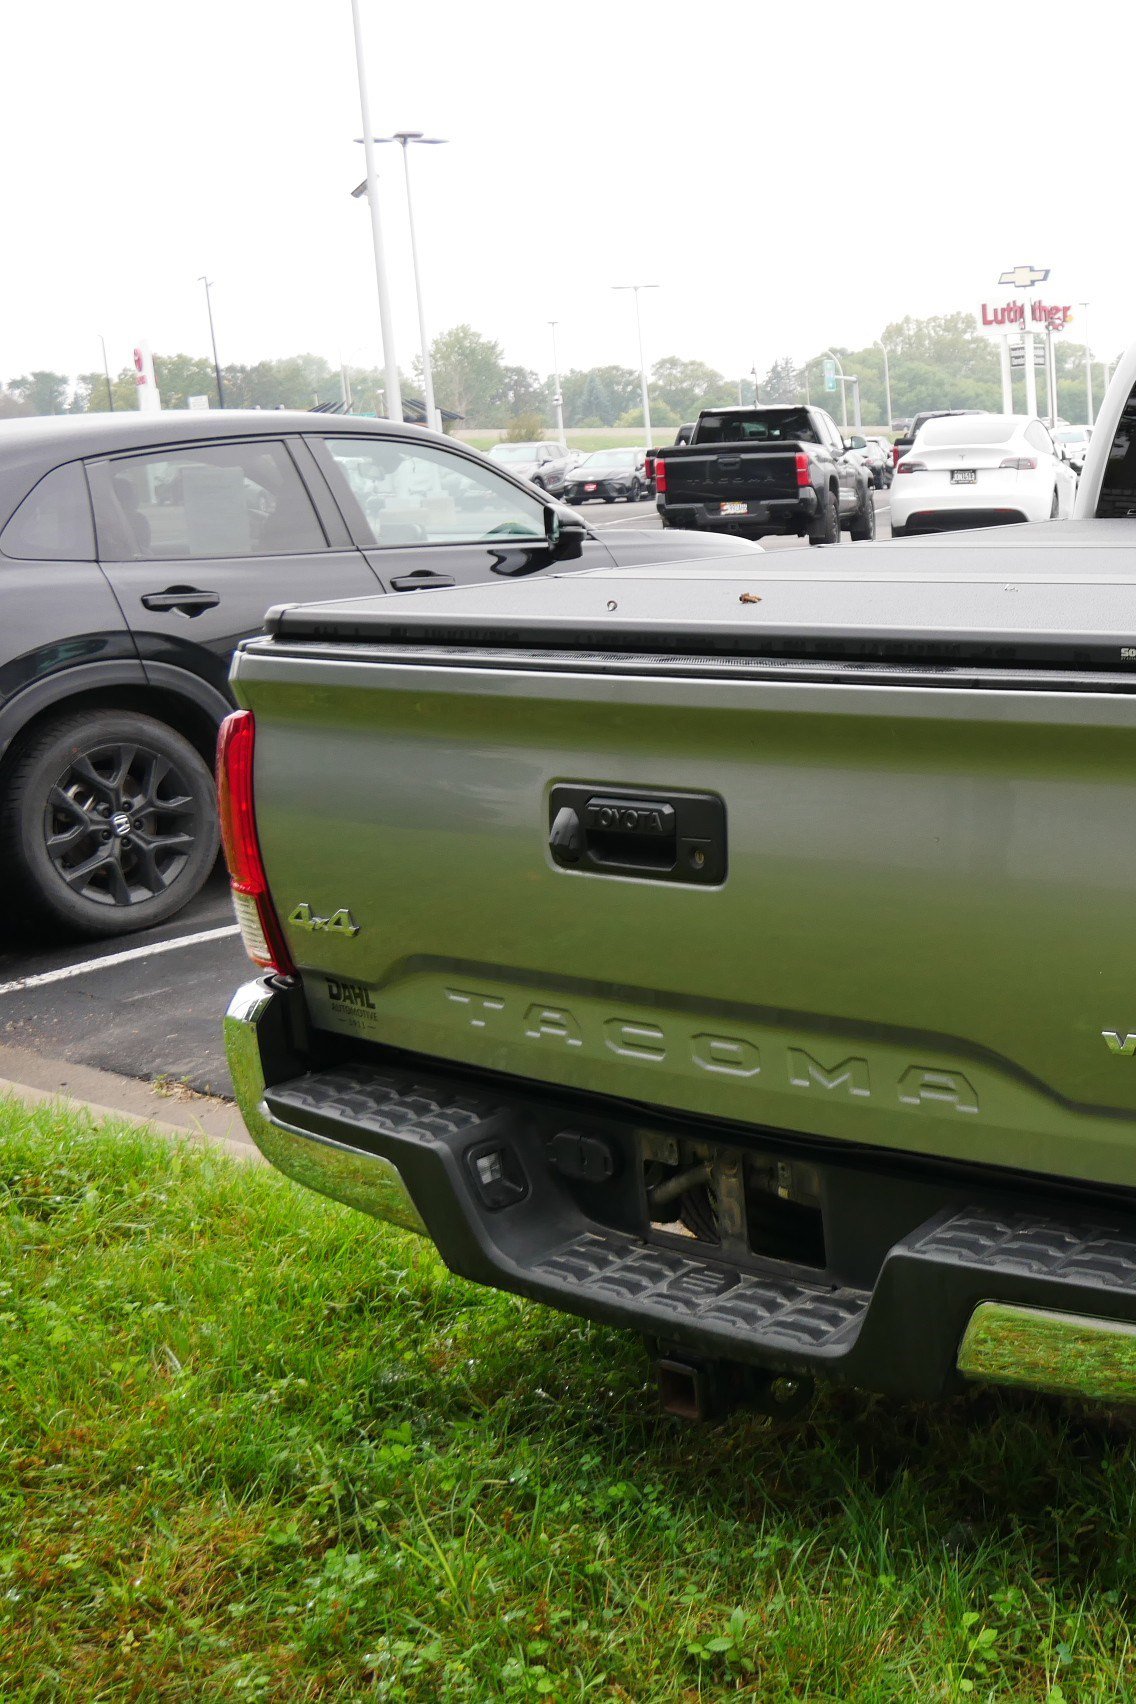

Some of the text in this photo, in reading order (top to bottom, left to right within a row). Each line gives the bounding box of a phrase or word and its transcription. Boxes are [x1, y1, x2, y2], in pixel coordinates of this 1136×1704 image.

[587, 805, 664, 832] TOYOTA
[287, 902, 360, 937] 4x4
[325, 977, 376, 1010] DAHL
[445, 987, 981, 1115] TACOMA
